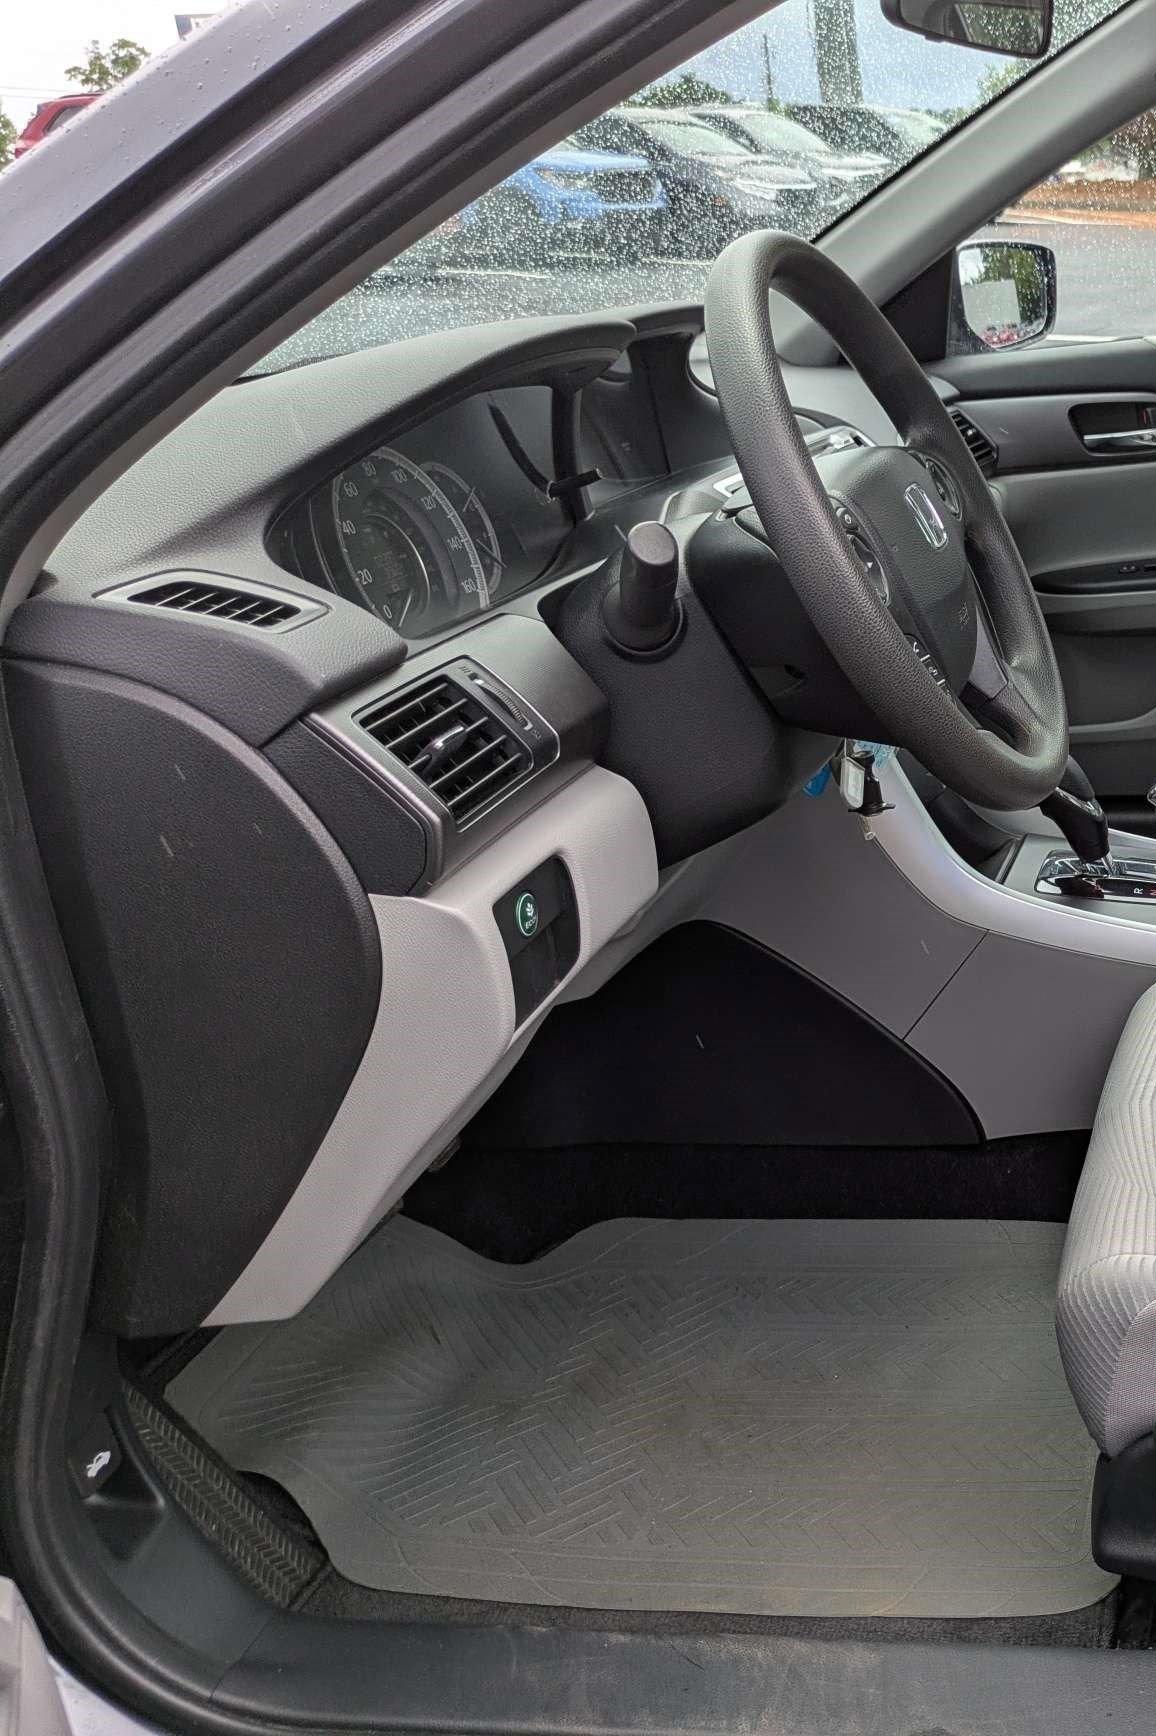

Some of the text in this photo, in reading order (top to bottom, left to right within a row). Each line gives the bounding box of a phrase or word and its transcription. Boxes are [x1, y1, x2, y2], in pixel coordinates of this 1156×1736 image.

[344, 482, 358, 498] 60
[421, 496, 436, 510] 120
[342, 520, 356, 535] 40
[448, 535, 462, 551] 140
[359, 569, 372, 585] 20
[461, 579, 476, 593] 160
[383, 606, 392, 619] 0
